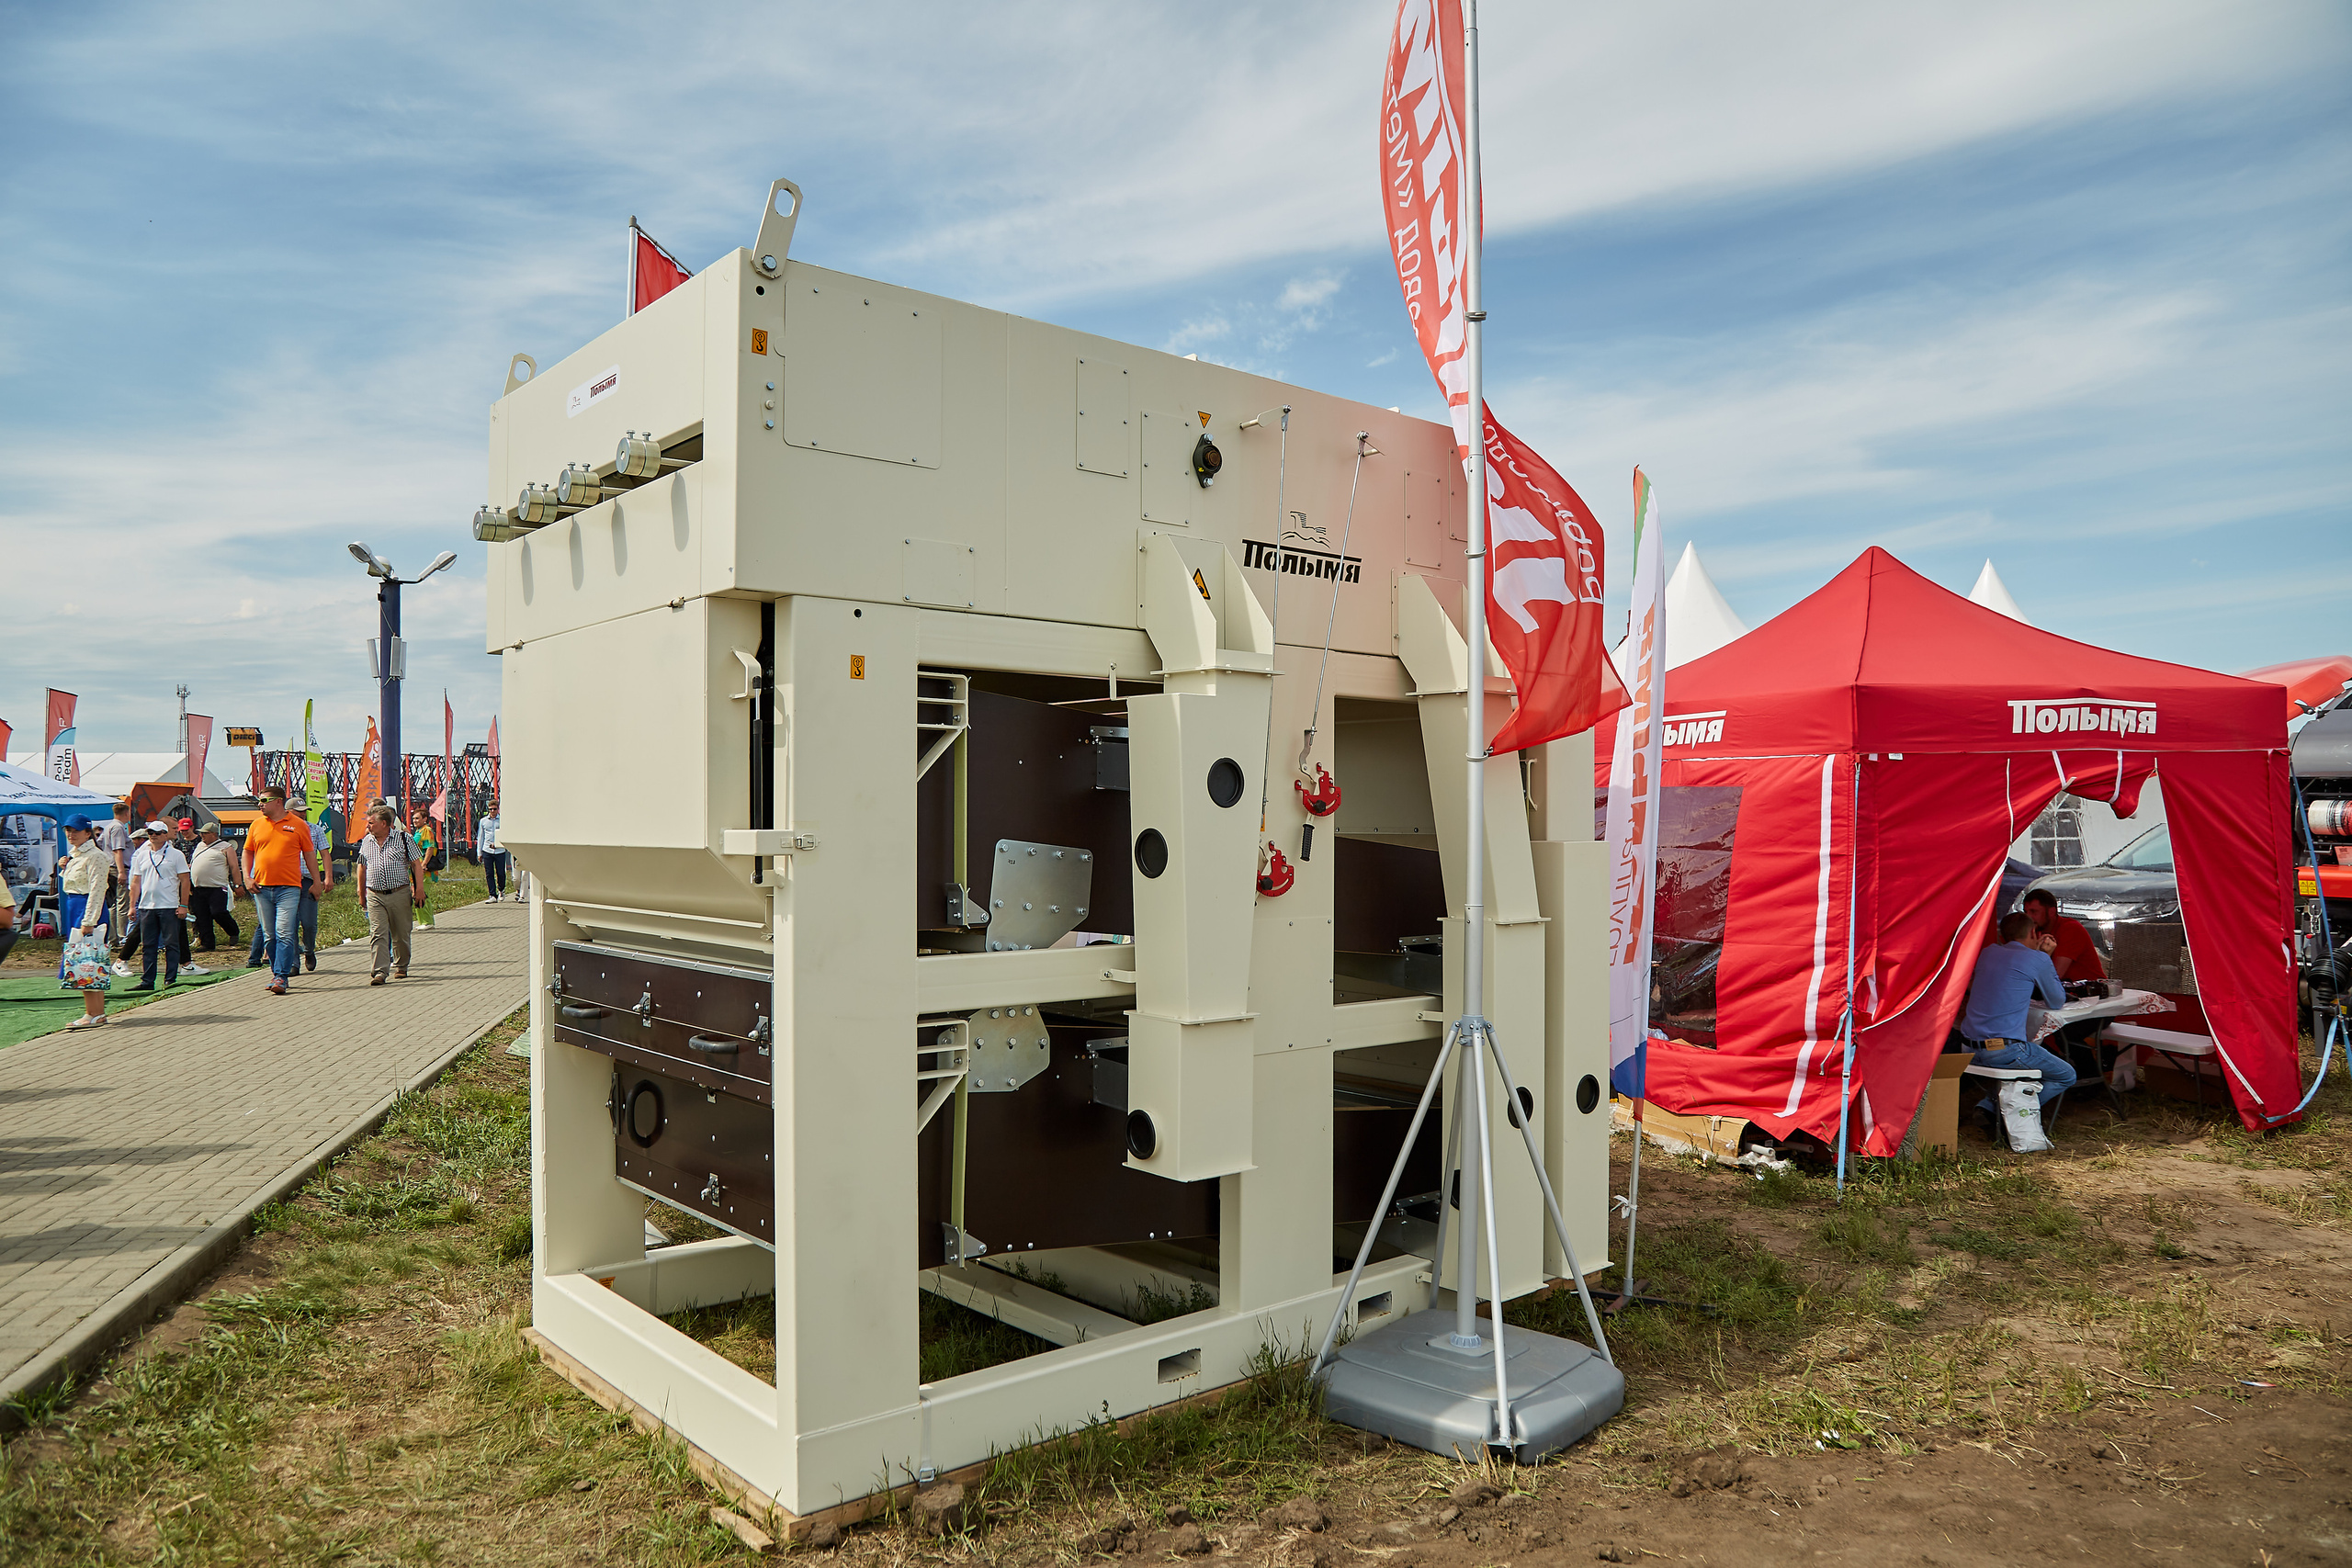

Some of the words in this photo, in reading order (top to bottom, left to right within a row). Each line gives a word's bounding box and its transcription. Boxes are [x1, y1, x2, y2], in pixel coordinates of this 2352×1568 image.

[590, 373, 616, 399] Полымя
[1242, 538, 1363, 585] Полымя
[1661, 710, 1727, 750] ымя
[2007, 697, 2157, 739] Полымя
[54, 755, 64, 781] Poly
[62, 748, 72, 783] Team
